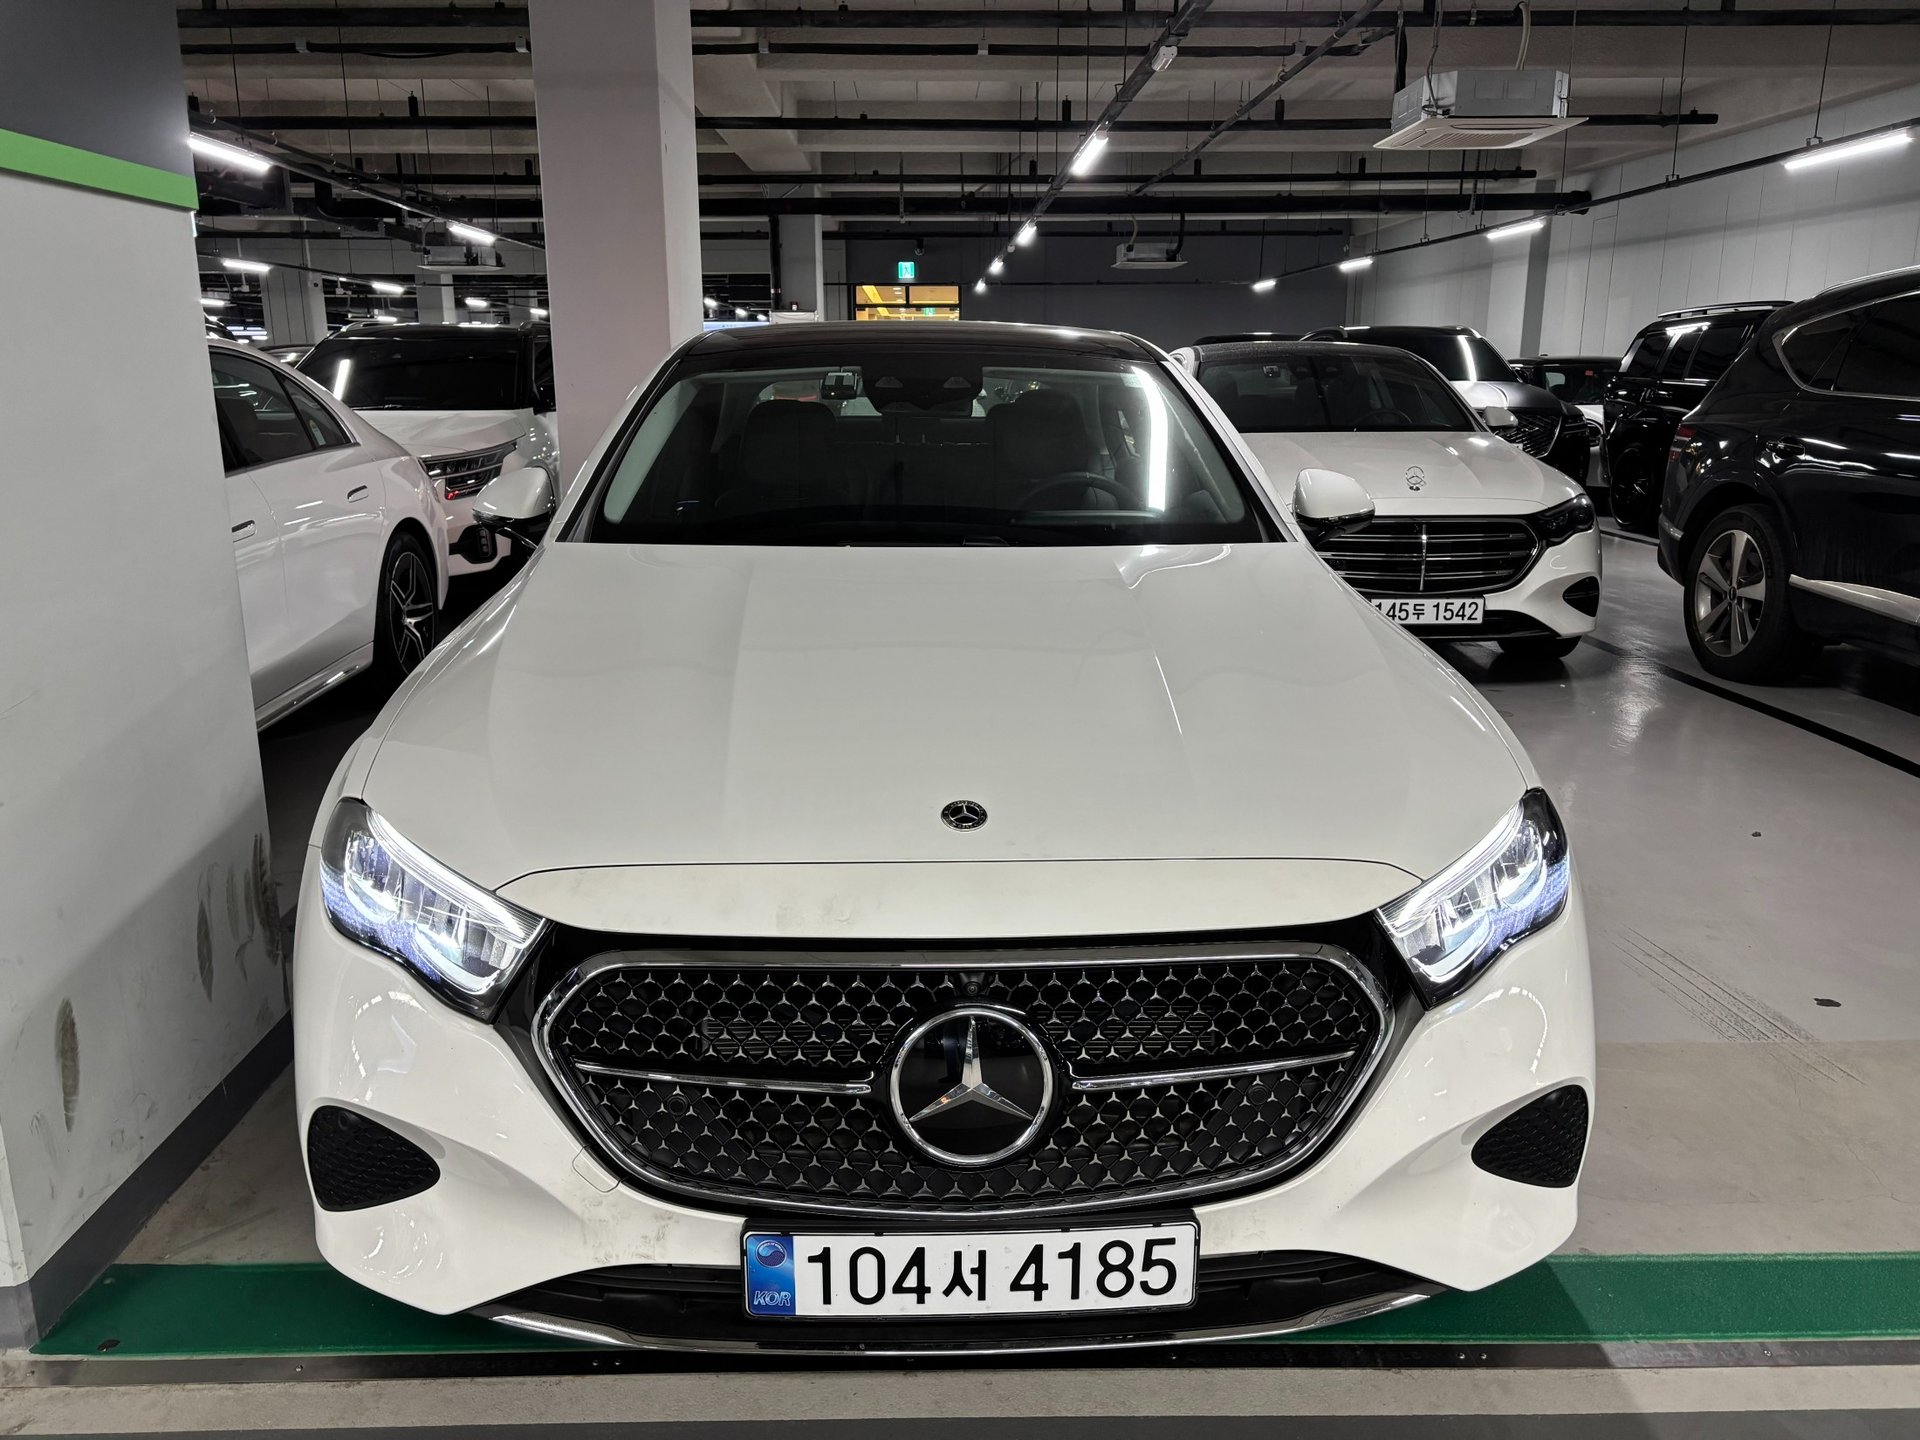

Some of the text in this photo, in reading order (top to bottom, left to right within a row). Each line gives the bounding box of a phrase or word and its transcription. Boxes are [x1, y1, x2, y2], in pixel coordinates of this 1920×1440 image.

[1432, 602, 1479, 621] 1542
[807, 1237, 1178, 1305] 104서 4185
[753, 1290, 791, 1307] KOR
